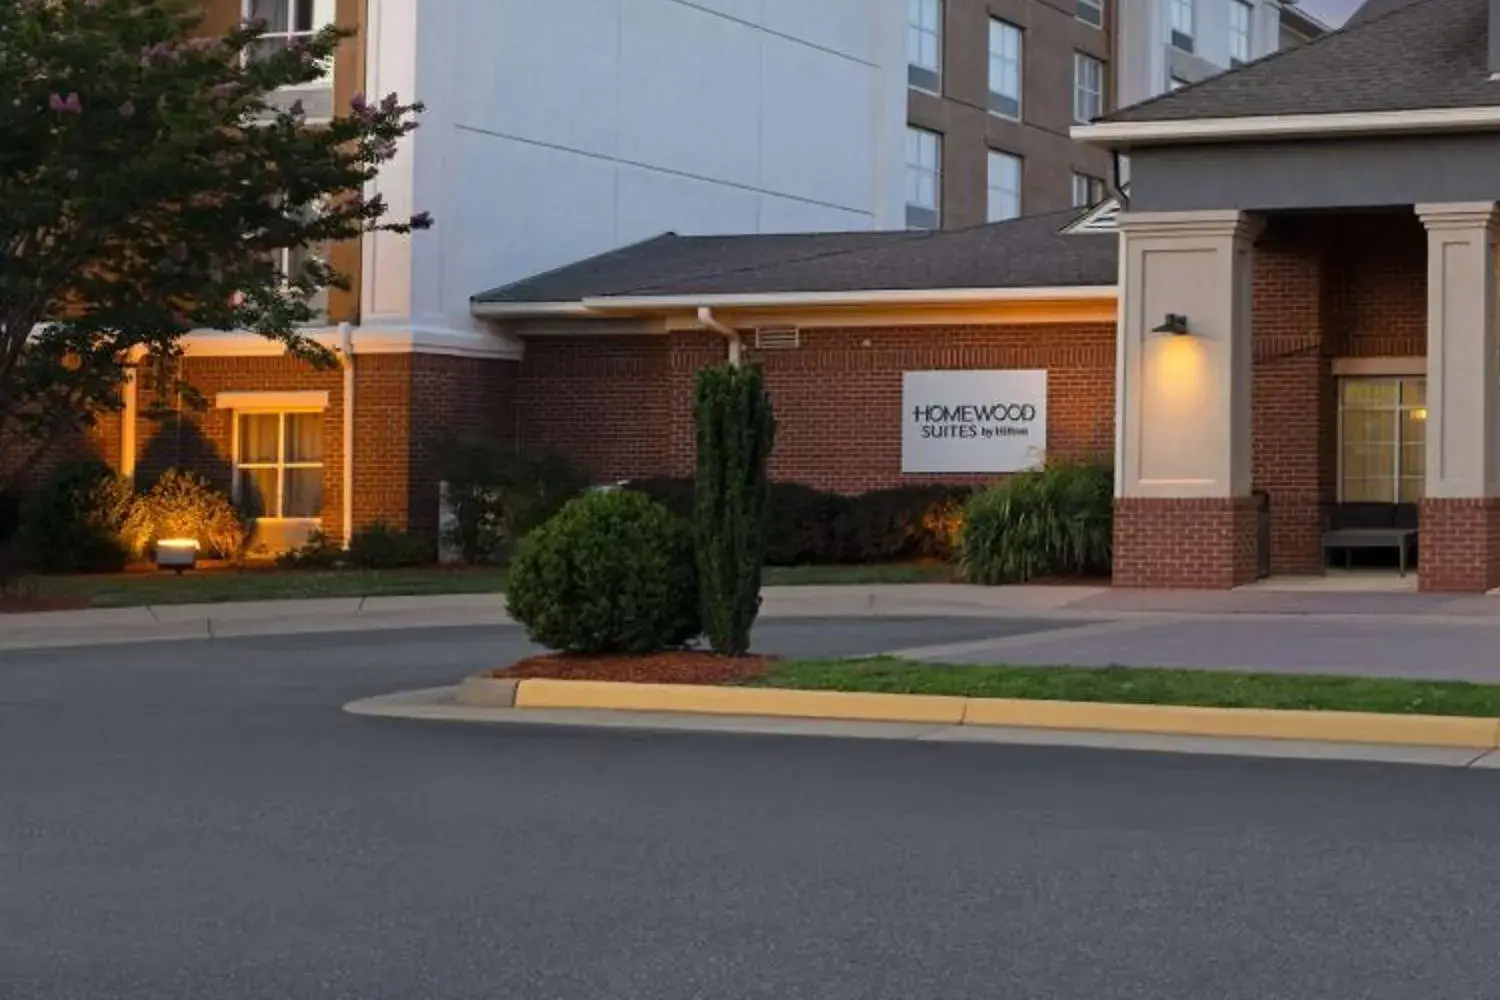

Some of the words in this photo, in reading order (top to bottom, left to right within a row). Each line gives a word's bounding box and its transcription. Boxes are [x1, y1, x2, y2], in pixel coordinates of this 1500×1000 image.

[913, 403, 1036, 422] HOMEWOOD
[921, 424, 977, 438] SUITES
[981, 427, 993, 438] by
